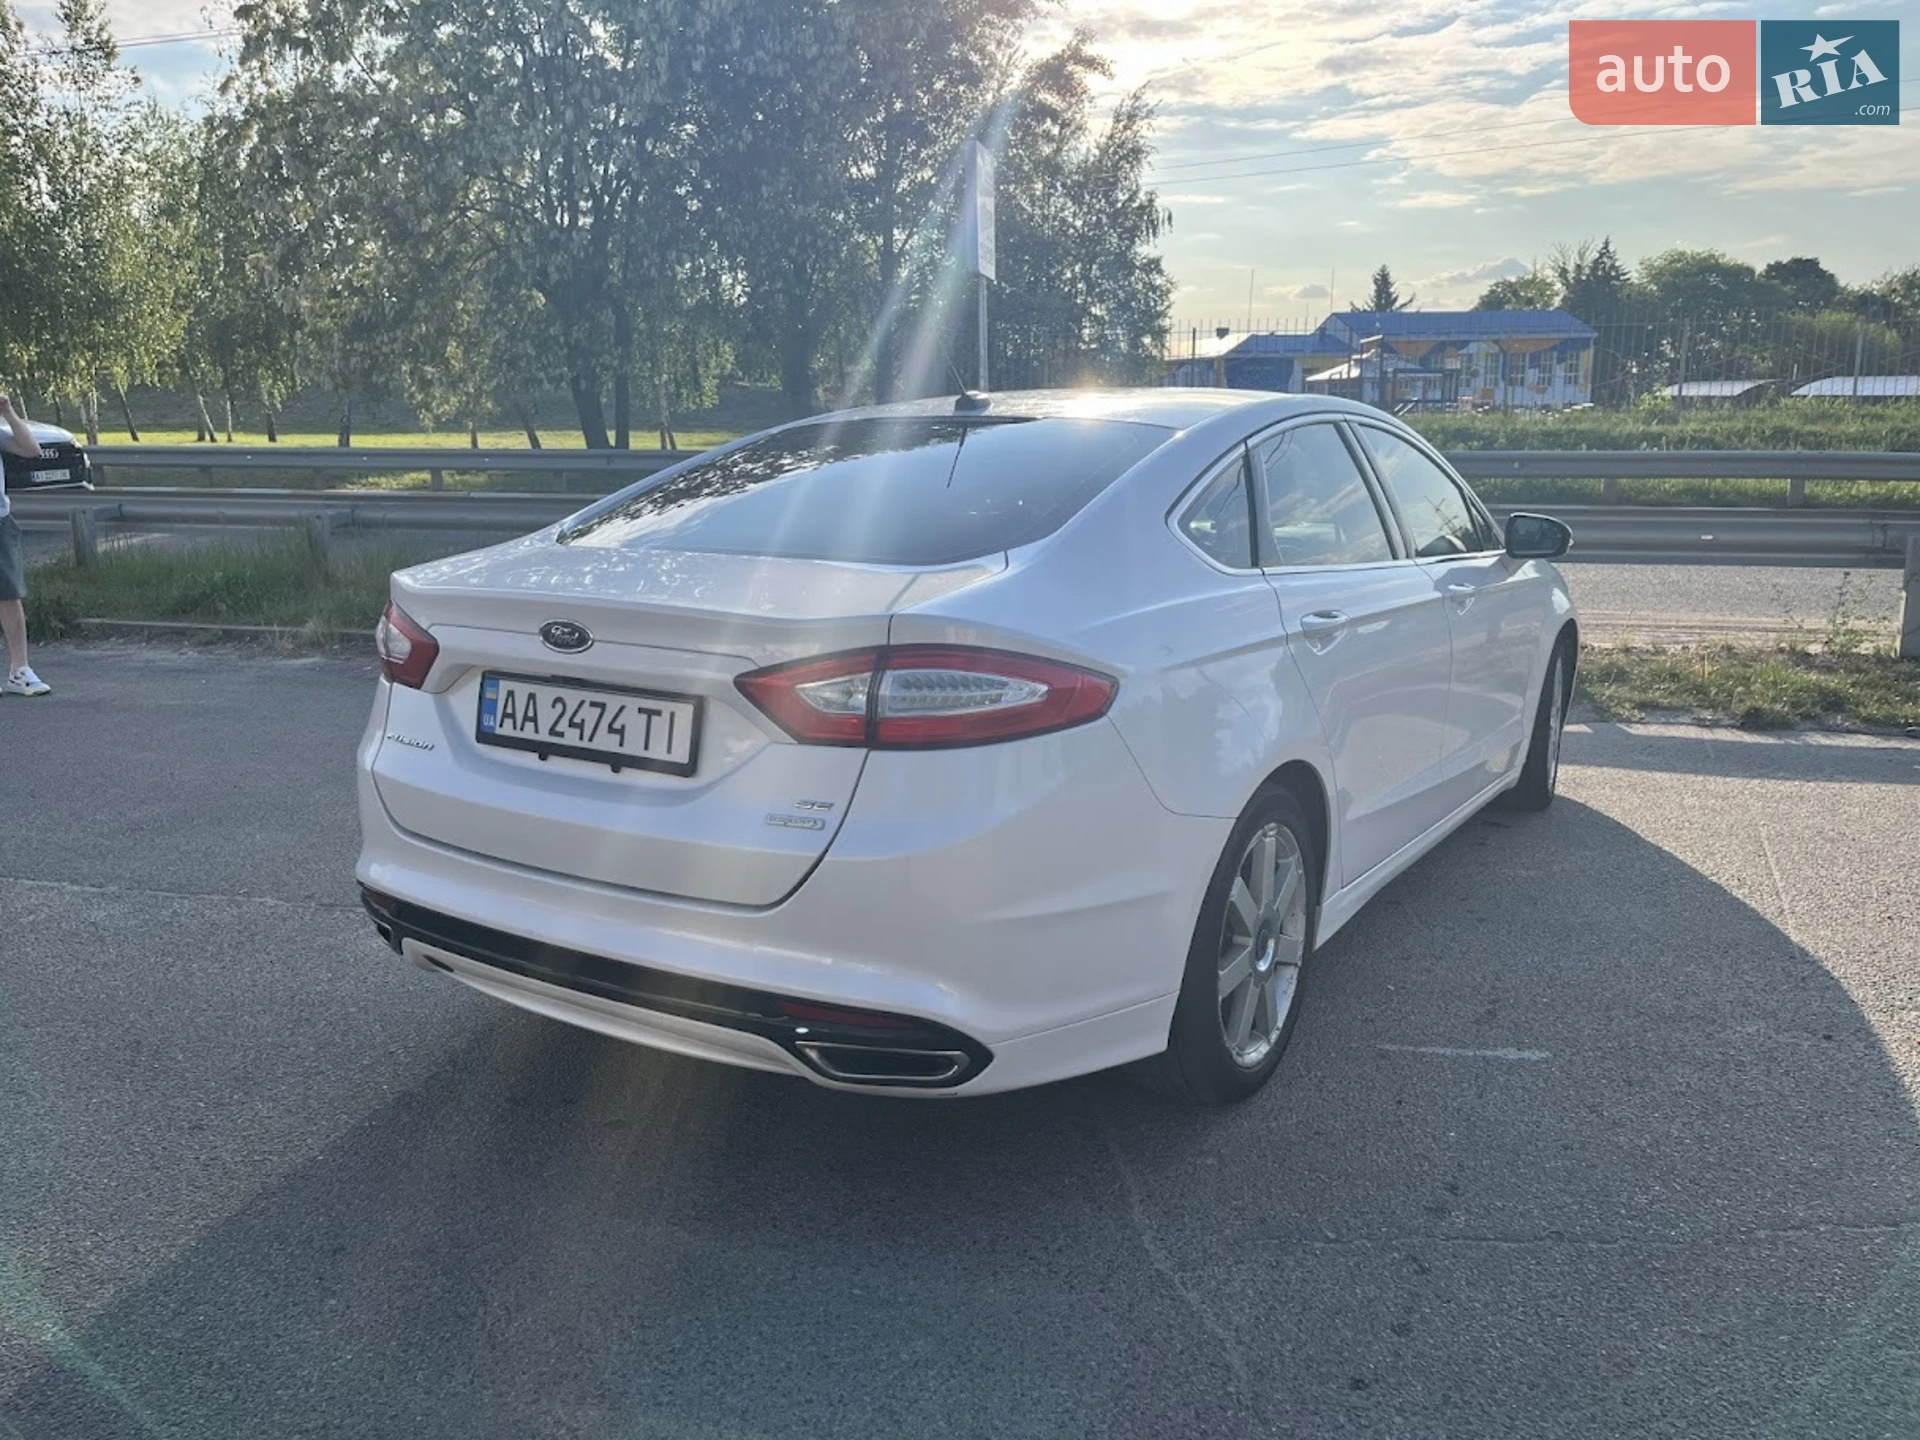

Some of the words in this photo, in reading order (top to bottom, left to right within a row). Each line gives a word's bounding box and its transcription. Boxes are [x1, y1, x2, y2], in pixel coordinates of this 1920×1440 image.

[550, 625, 580, 645] Ford
[483, 715, 496, 727] UA
[498, 689, 540, 735] AA
[548, 696, 627, 748] 2474
[637, 706, 676, 755] TI
